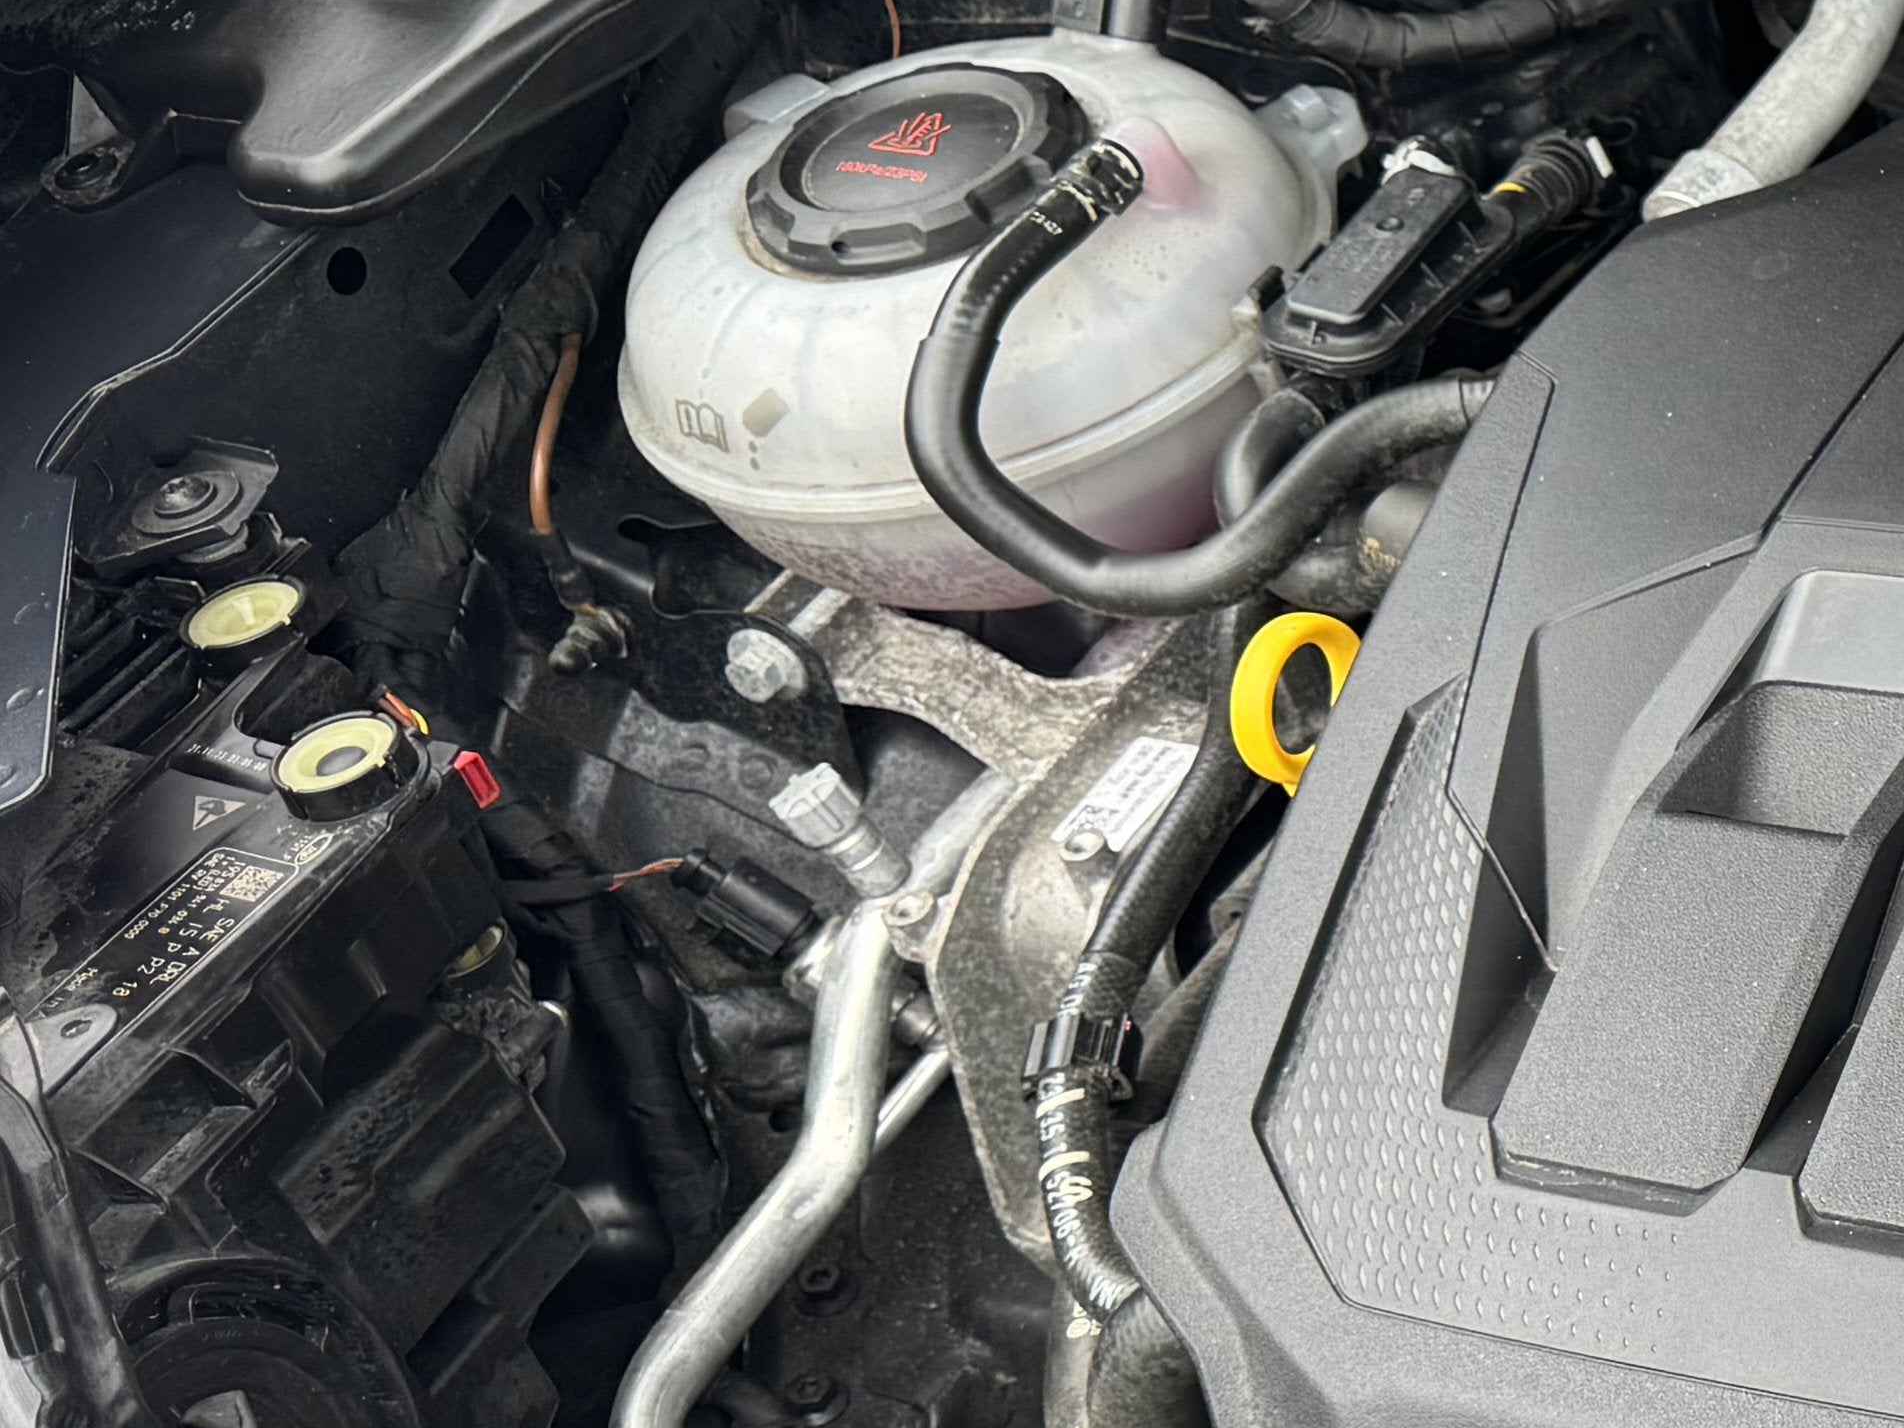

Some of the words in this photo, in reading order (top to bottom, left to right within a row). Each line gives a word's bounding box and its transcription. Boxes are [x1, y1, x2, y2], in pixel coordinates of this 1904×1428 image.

[200, 918, 235, 942] SAE
[183, 947, 200, 957] A
[137, 957, 166, 975] P2
[149, 961, 187, 985] DRL
